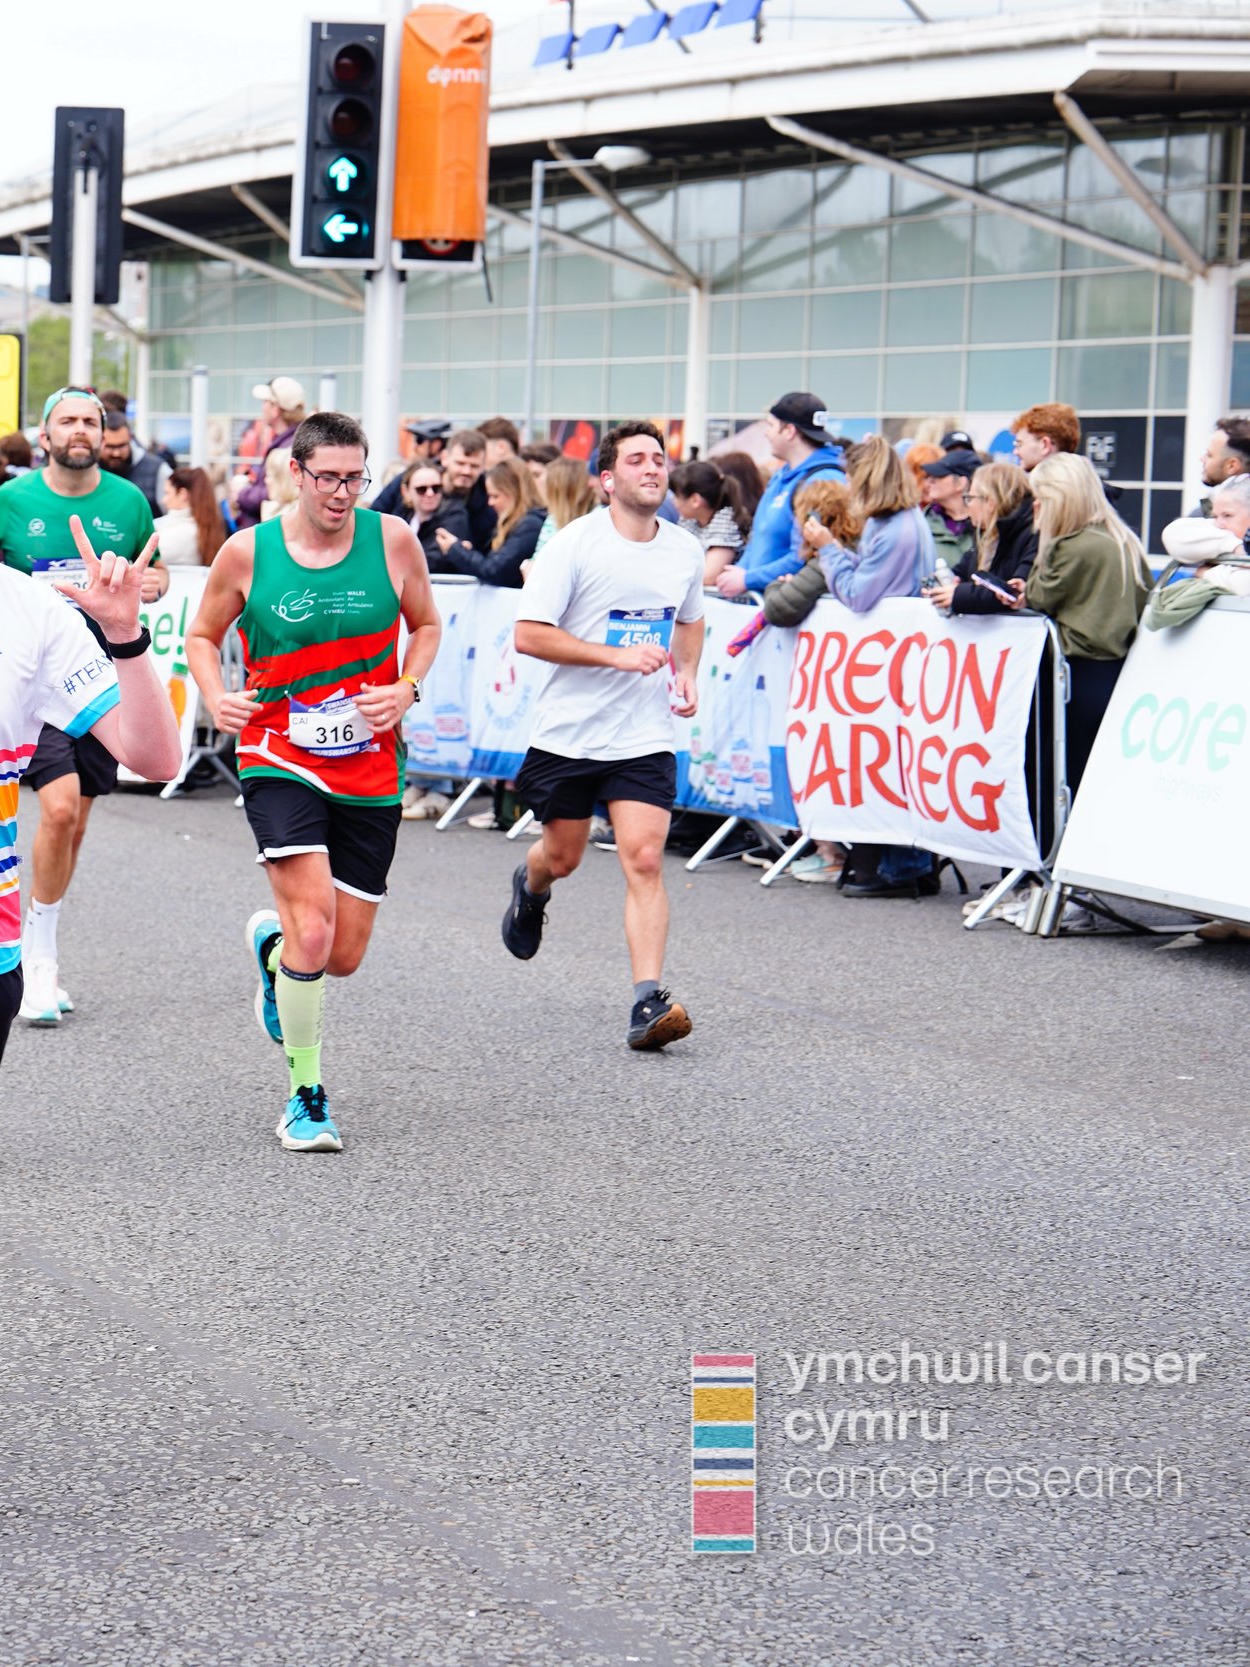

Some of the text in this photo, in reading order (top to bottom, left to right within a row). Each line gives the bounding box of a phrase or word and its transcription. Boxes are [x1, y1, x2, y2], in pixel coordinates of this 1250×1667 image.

[608, 621, 651, 633] BENJAMIN
[618, 631, 662, 648] 4508
[788, 629, 1012, 735] BRECON
[292, 716, 309, 725] CAI
[315, 724, 354, 744] 316
[1121, 692, 1248, 772] core
[786, 720, 1006, 834] CARREG
